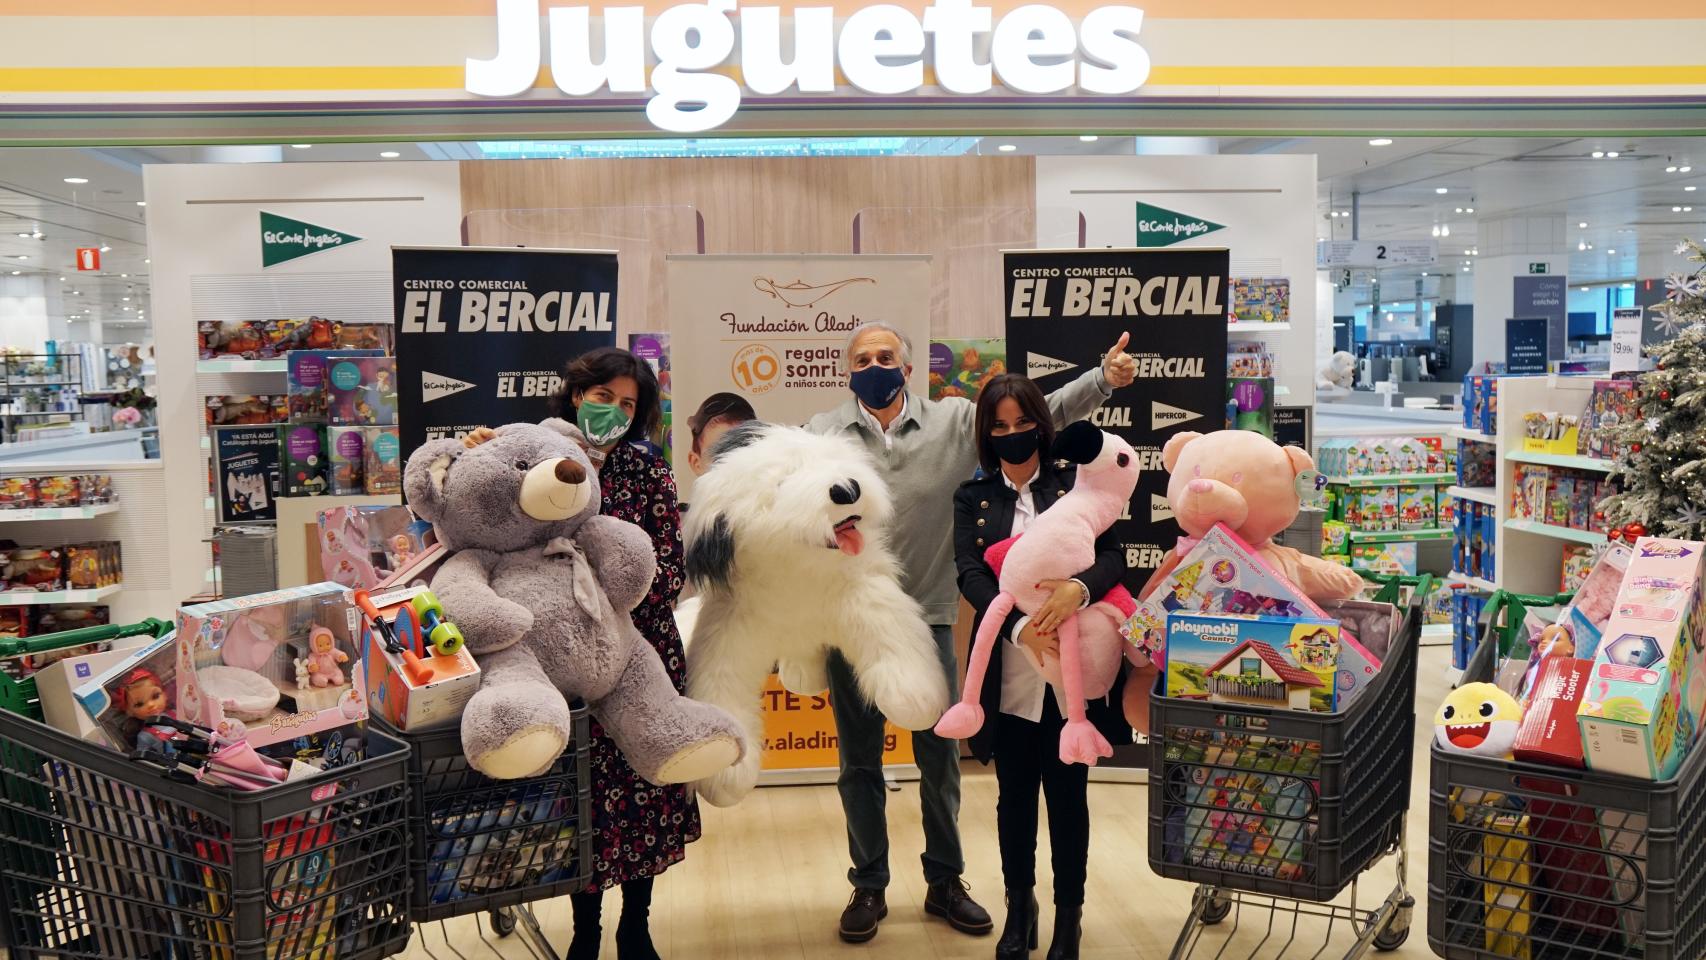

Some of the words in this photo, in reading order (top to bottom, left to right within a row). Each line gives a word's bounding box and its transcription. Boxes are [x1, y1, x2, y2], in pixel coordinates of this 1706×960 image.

[465, 0, 1151, 133] Juguetes
[1139, 220, 1149, 232] El
[1150, 220, 1173, 232] Corte
[1174, 217, 1208, 236] Inglés
[264, 231, 275, 244] El
[276, 231, 303, 244] Corte
[303, 228, 342, 248] Inglés
[1377, 245, 1387, 259] 2
[1013, 268, 1060, 278] CENTRO
[1064, 267, 1134, 277] COMERCIAL
[403, 279, 454, 290] CENTRO
[458, 280, 528, 290] COMERCIAL
[1010, 278, 1051, 317] EL
[1062, 276, 1223, 317] BERCIAL
[401, 291, 447, 333] EL
[458, 290, 613, 333] BERCIAL
[720, 312, 809, 334] Fundación
[814, 311, 863, 333] Aladi
[785, 347, 844, 362] regala
[737, 354, 778, 387] 10
[496, 377, 517, 398] EL
[793, 379, 817, 388] niños
[1155, 412, 1187, 420] HIPERCOR
[227, 458, 259, 470] JUGUETES
[1171, 620, 1239, 636] playmobil
[1201, 634, 1237, 644] Country
[1563, 669, 1580, 702] Scooter
